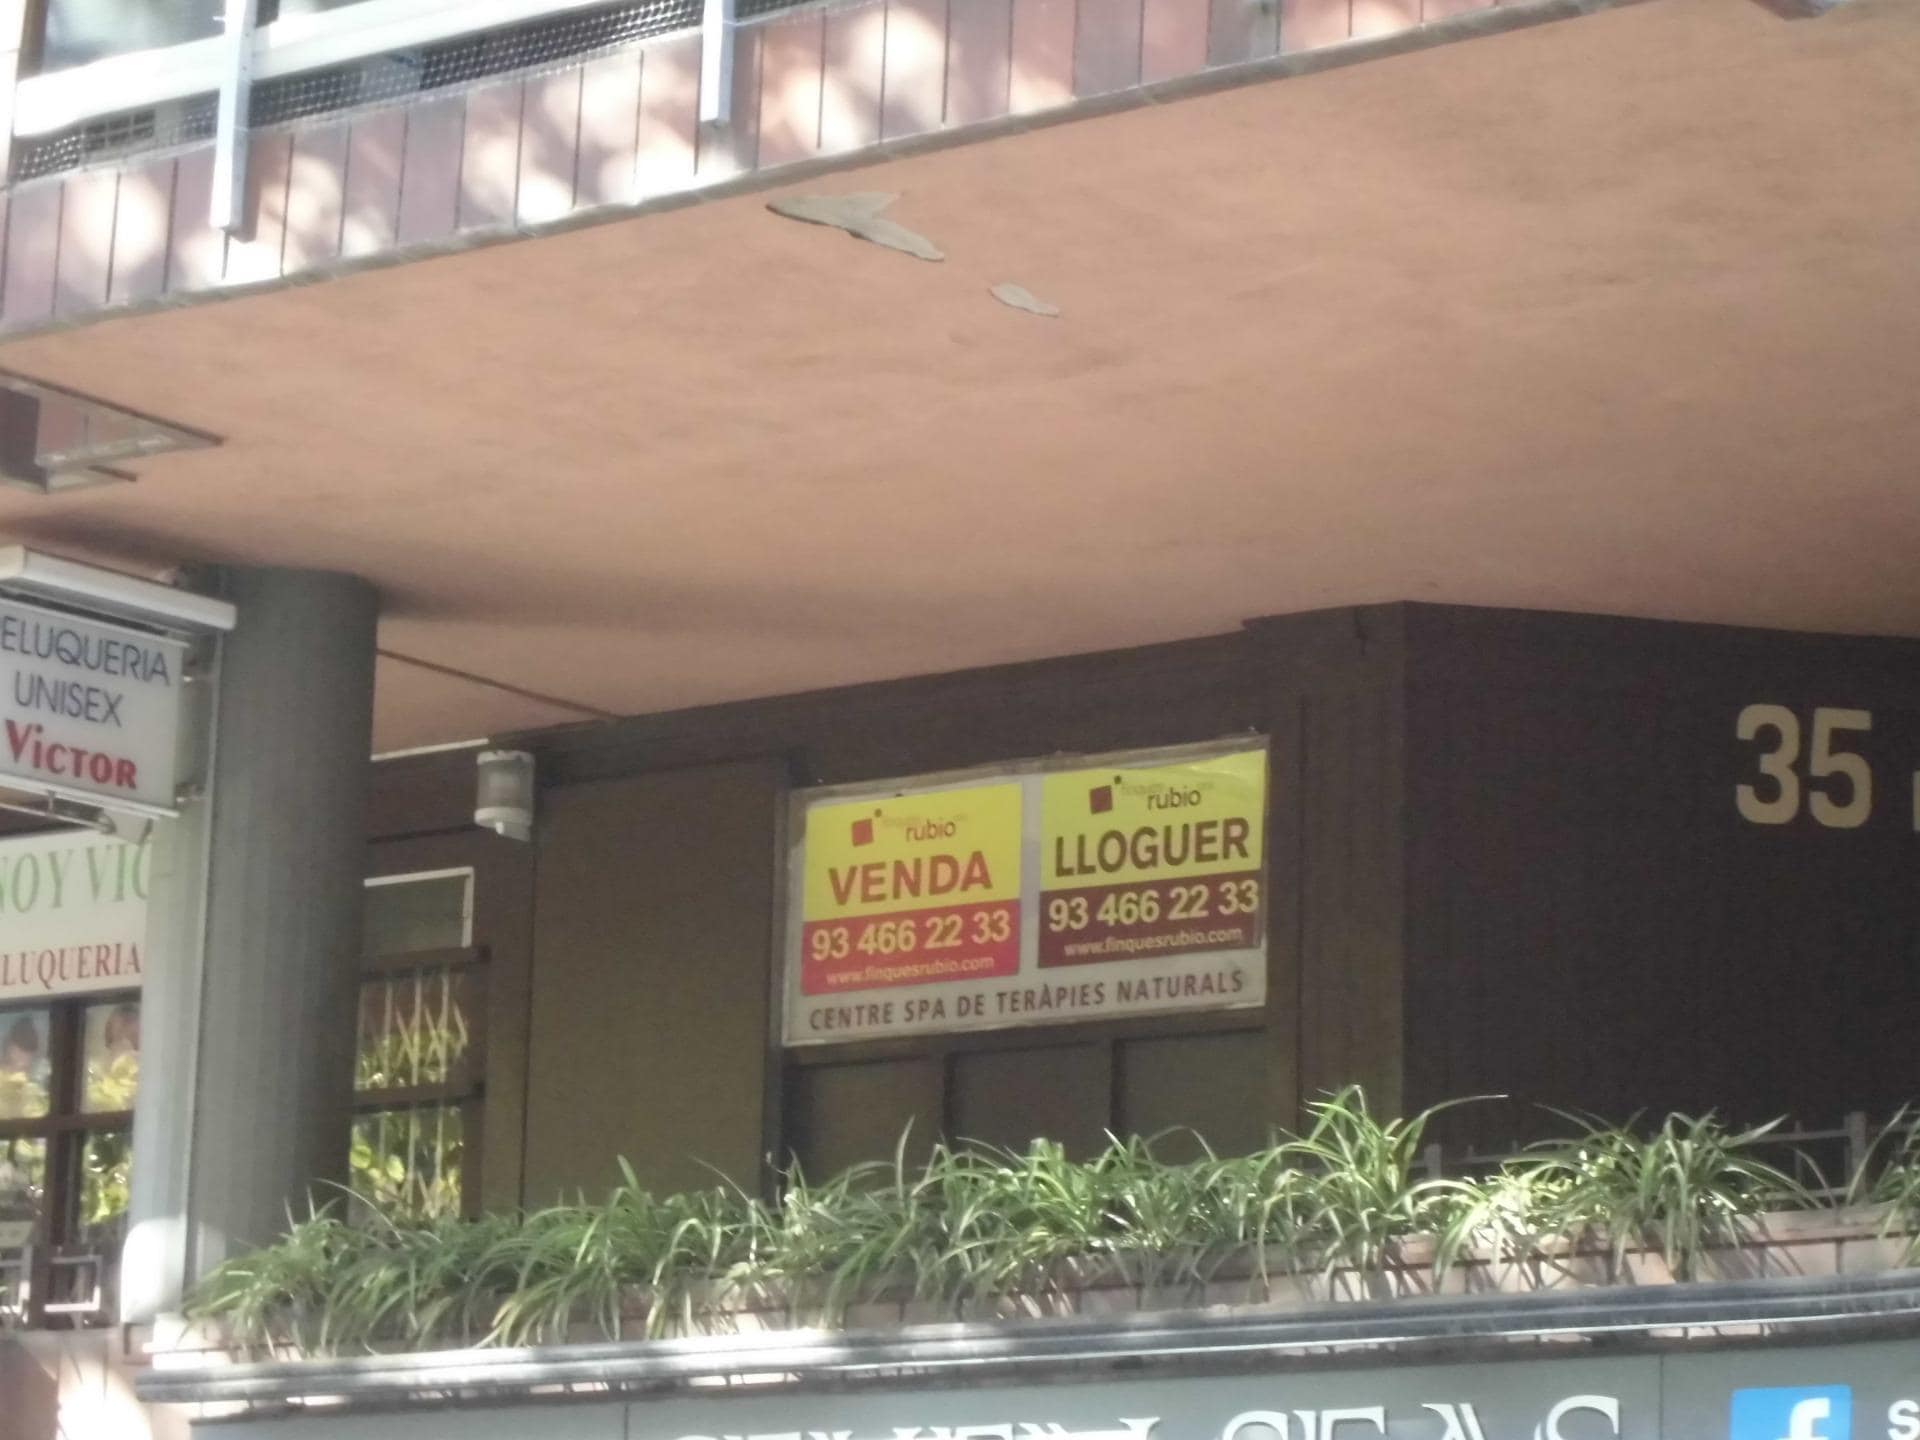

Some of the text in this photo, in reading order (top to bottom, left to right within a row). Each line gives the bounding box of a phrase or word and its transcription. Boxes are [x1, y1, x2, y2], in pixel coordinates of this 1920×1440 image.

[14, 671, 123, 728] UNISEX
[1736, 703, 1872, 829] 35
[1147, 786, 1201, 810] rubio
[905, 818, 956, 842] rubio
[1055, 817, 1249, 877] LLOGUER
[828, 851, 993, 906] VENDA
[1049, 880, 1259, 932] 93 466 22 33
[811, 910, 1011, 961] 93 466 22 33
[1064, 927, 1243, 956] www.finquesrubio.com
[826, 955, 995, 986] www.finquesrubio.com
[809, 970, 1244, 1031] CENTRE SPA DE TERÀPIES NATURALS
